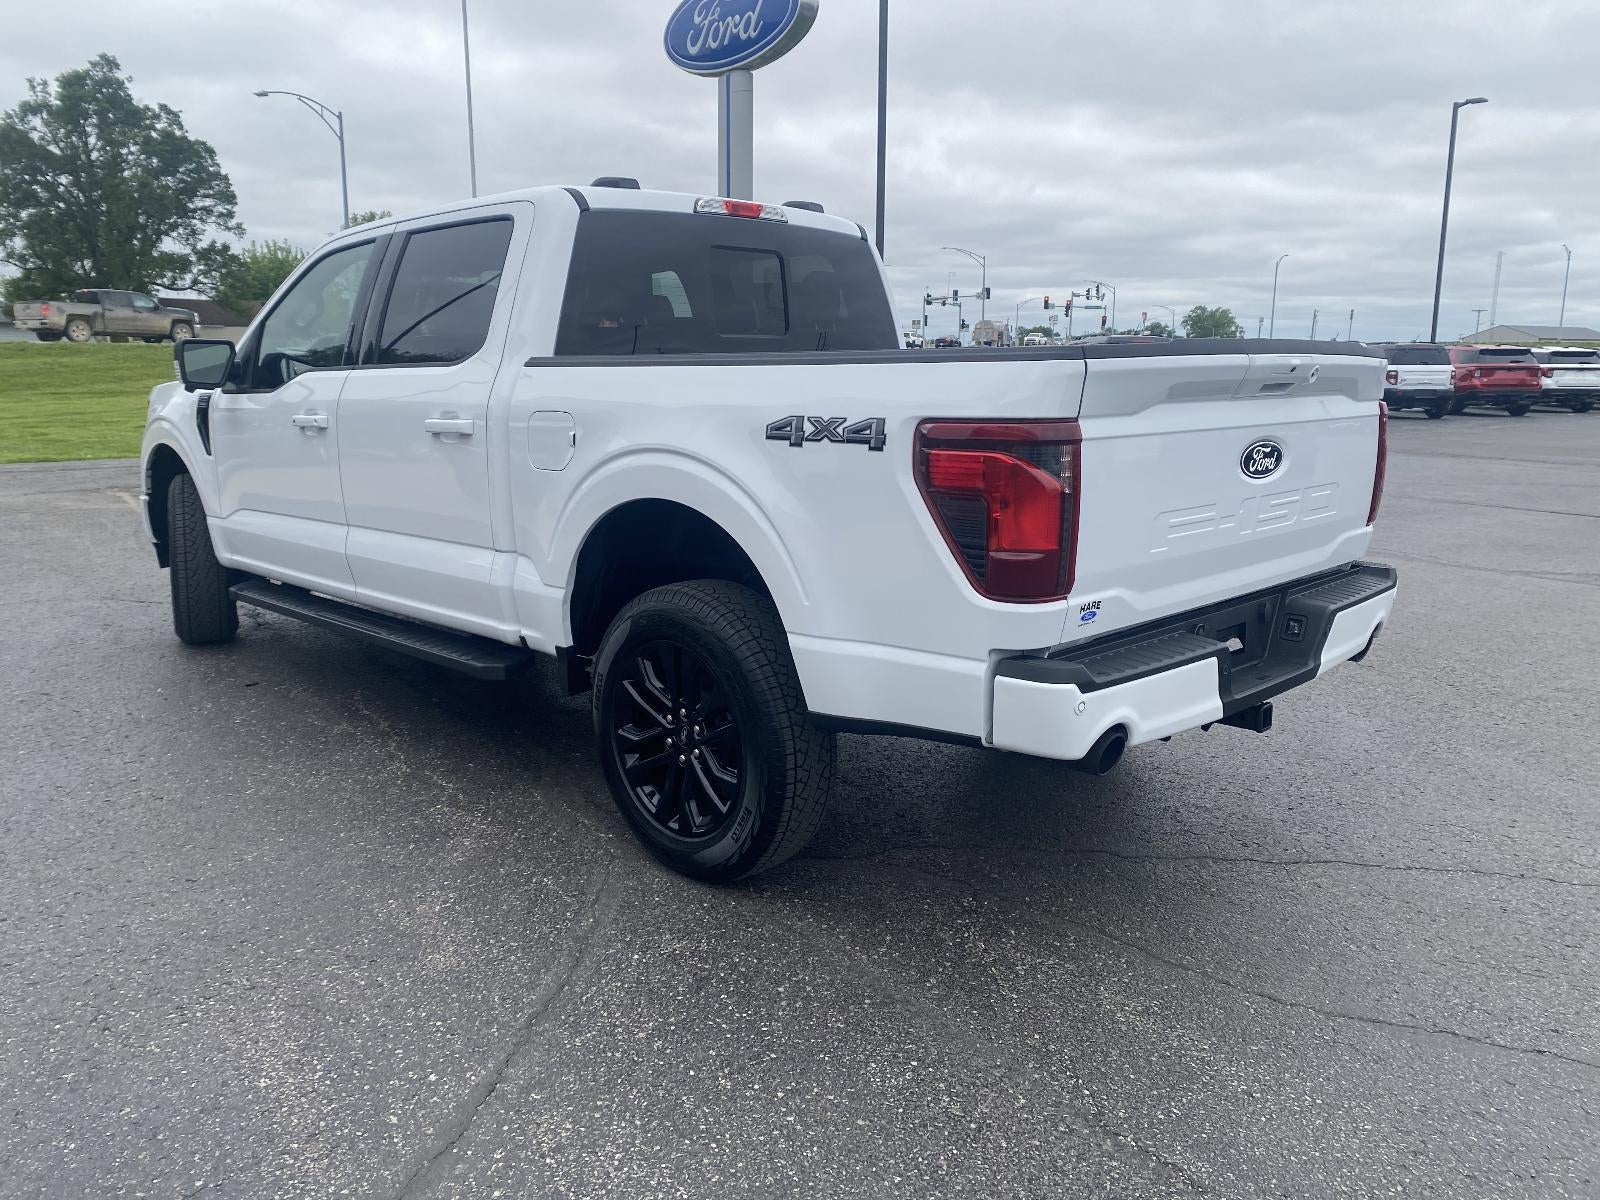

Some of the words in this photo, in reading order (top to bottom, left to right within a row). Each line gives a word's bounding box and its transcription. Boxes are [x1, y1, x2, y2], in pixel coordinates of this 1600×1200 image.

[687, 0, 763, 55] Ford
[1250, 446, 1277, 472] Ford
[1150, 482, 1340, 553] F-150
[1079, 600, 1102, 615] HARE
